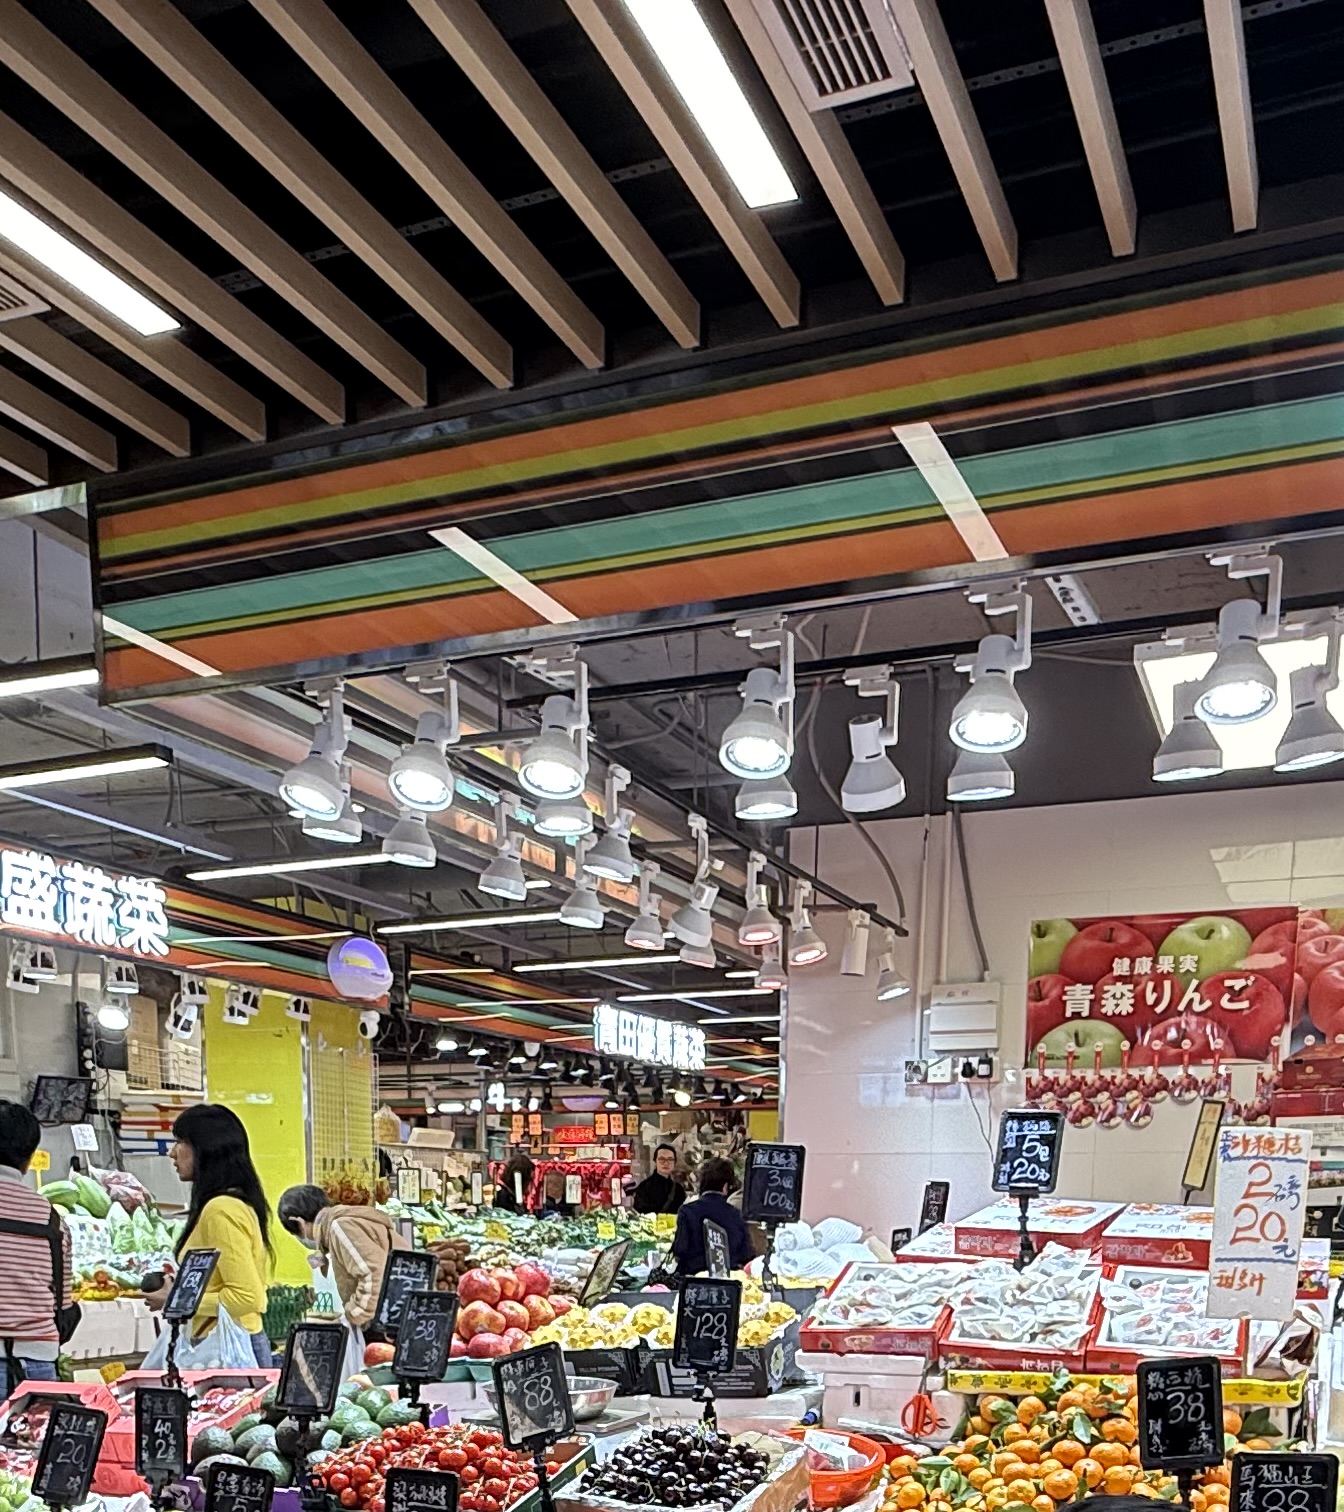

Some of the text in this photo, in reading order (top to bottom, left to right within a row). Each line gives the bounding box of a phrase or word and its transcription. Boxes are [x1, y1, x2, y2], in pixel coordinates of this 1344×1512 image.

[1112, 954, 1198, 976] 健康果実
[1062, 975, 1256, 1018] 青森りんご
[414, 1318, 438, 1342] 38
[692, 1312, 728, 1340] 128
[523, 1374, 555, 1411] 88
[1166, 1391, 1206, 1424] 38
